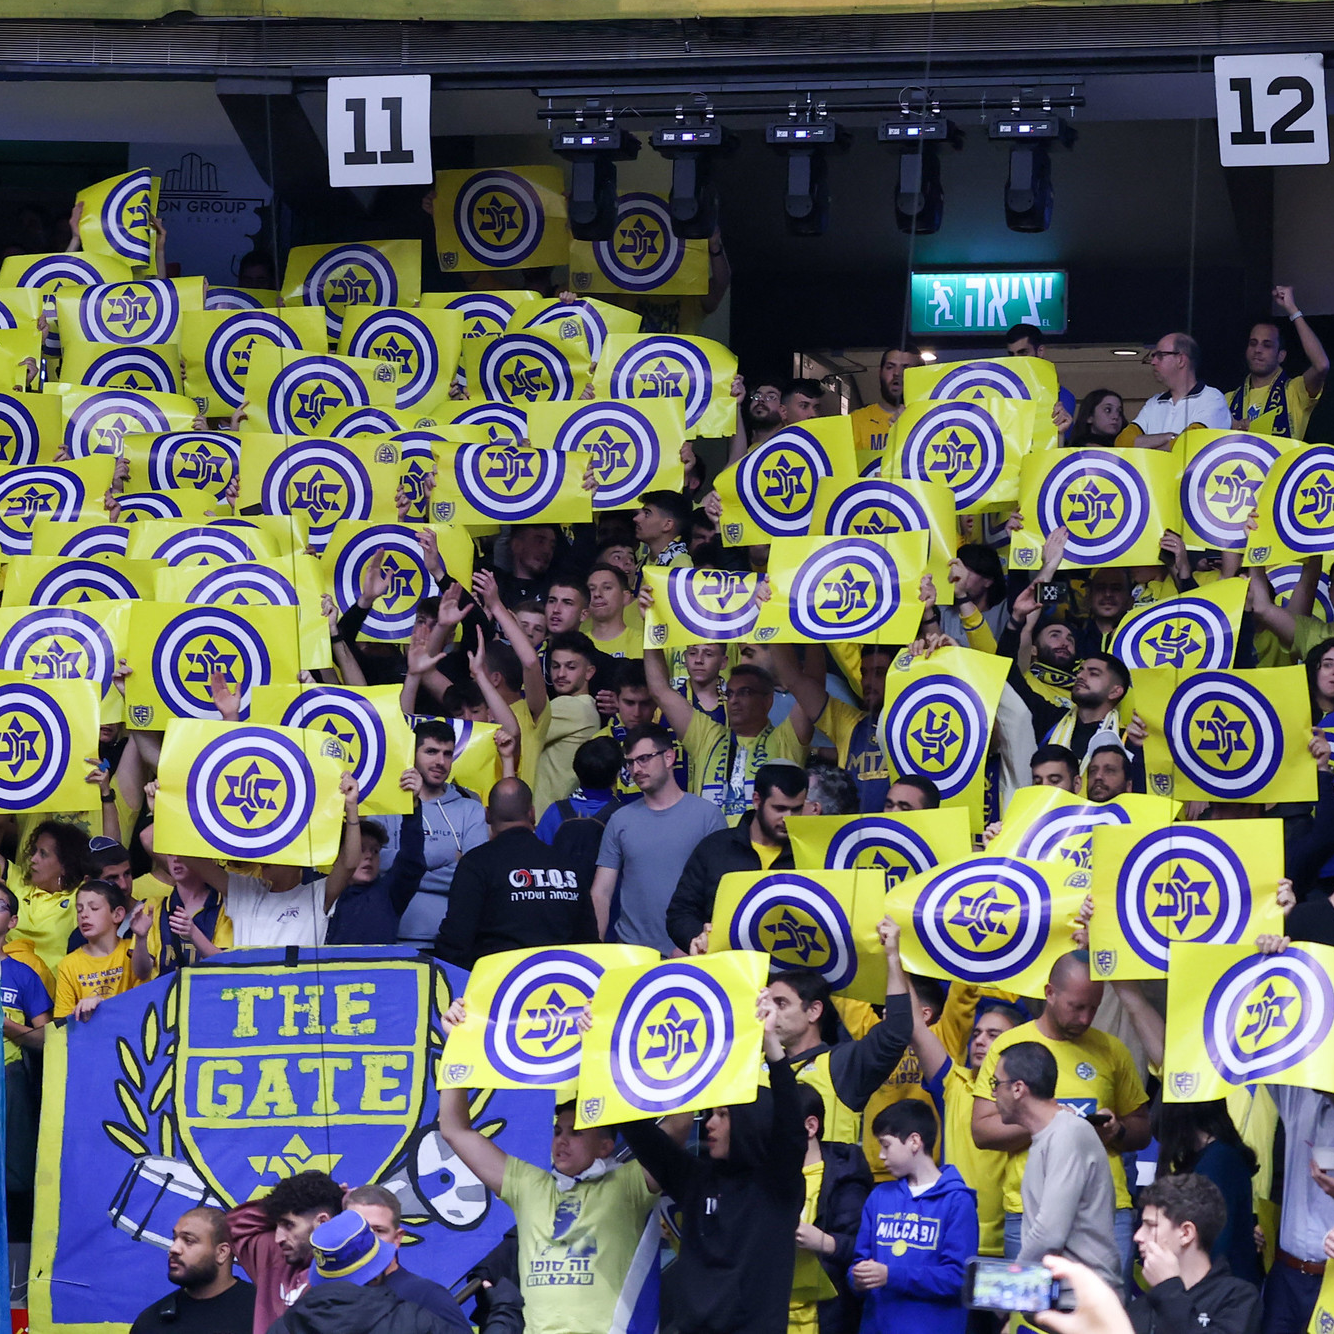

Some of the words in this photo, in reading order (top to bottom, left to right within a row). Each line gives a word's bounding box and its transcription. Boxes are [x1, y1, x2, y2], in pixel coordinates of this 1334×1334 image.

[343, 95, 414, 167] 11
[1229, 75, 1315, 146] 12
[157, 200, 181, 212] ON
[187, 200, 247, 214] GROUP
[964, 276, 1053, 327] יציאה
[220, 982, 377, 1038] THE
[196, 1053, 408, 1119] GATE
[876, 1221, 936, 1243] MACCABI
[569, 1259, 591, 1271] זה
